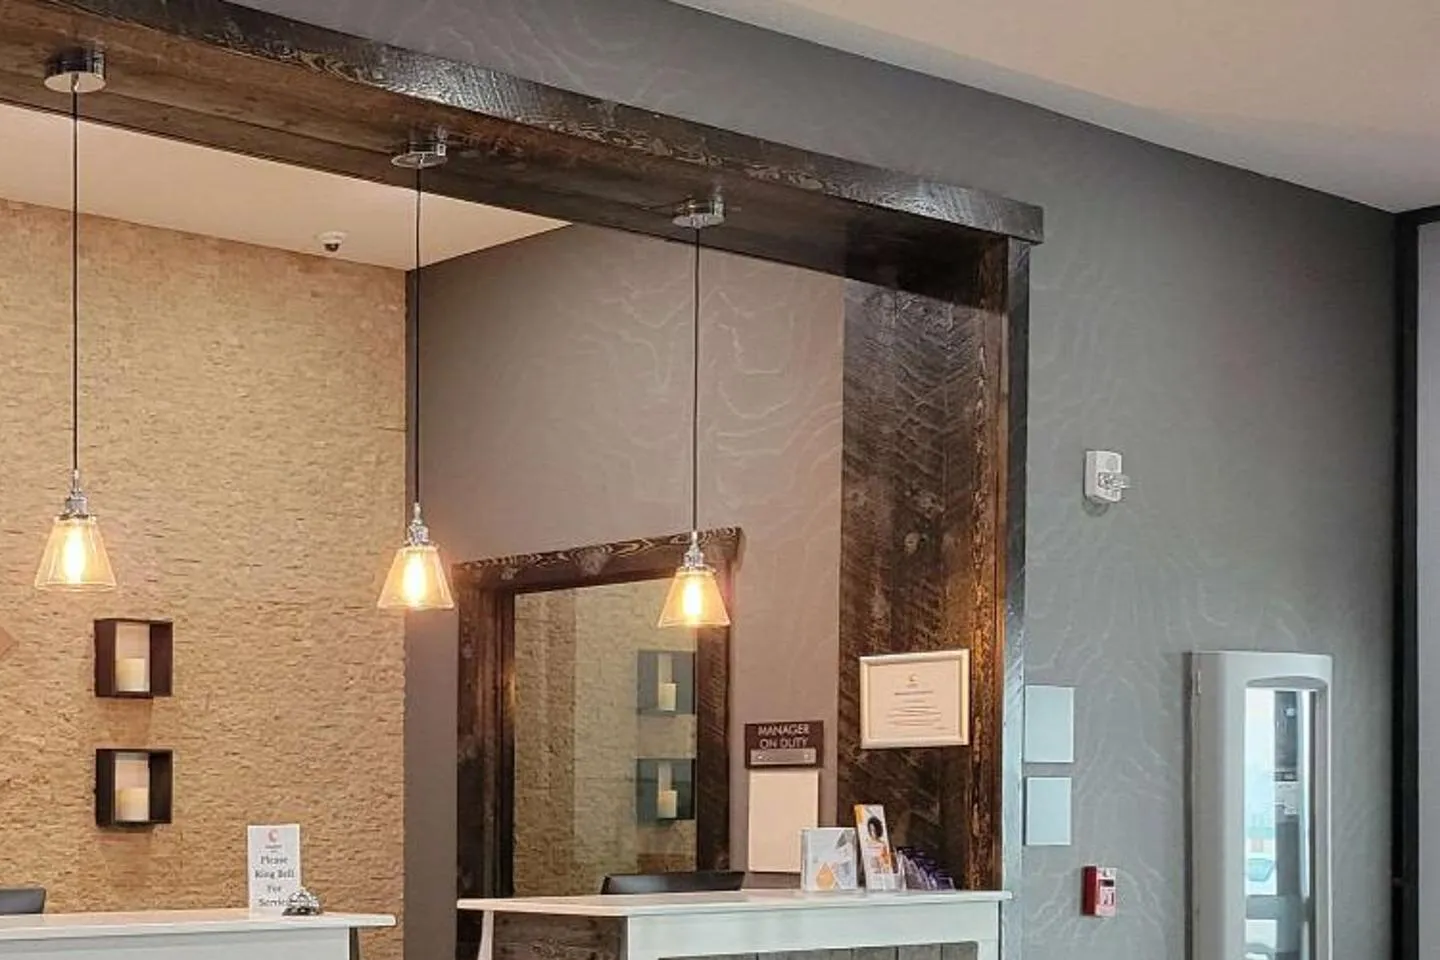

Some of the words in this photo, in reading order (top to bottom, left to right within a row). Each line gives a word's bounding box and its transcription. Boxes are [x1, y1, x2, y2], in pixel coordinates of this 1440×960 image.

[758, 723, 809, 736] MANAGER
[760, 738, 778, 749] ON
[780, 737, 809, 748] DUTY
